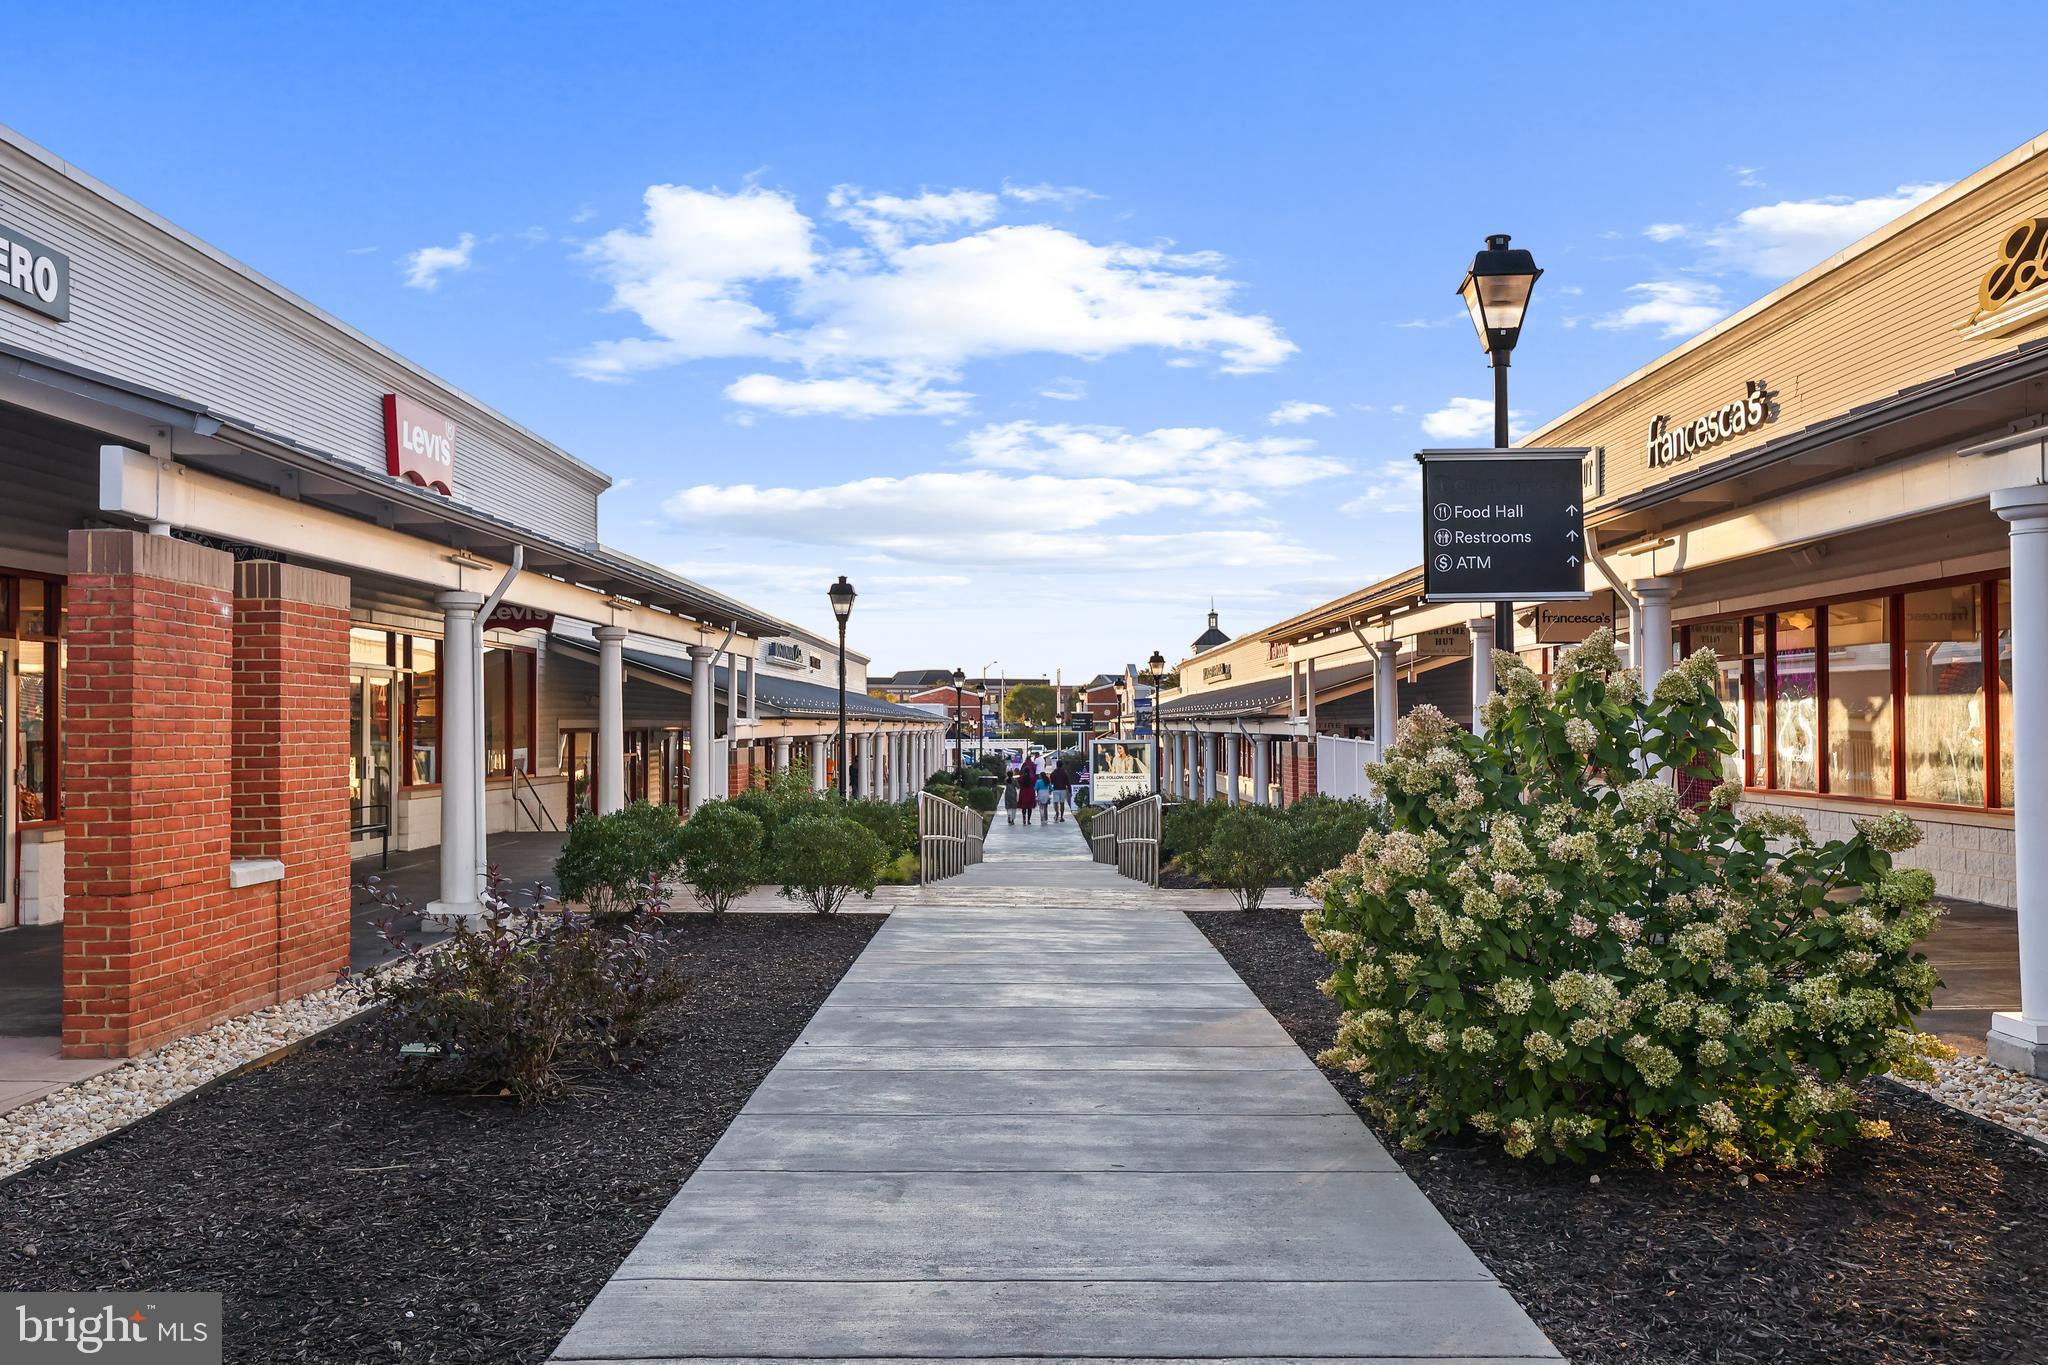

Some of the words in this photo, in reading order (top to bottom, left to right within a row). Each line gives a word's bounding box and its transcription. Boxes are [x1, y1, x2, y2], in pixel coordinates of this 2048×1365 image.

[1646, 380, 1767, 468] francesca's
[1454, 505, 1490, 518] Food
[1495, 504, 1524, 518] Hall
[1455, 531, 1532, 544] Restrooms
[1456, 556, 1491, 569] ATM
[1542, 609, 1611, 624] francesca's
[1435, 638, 1455, 646] HUT
